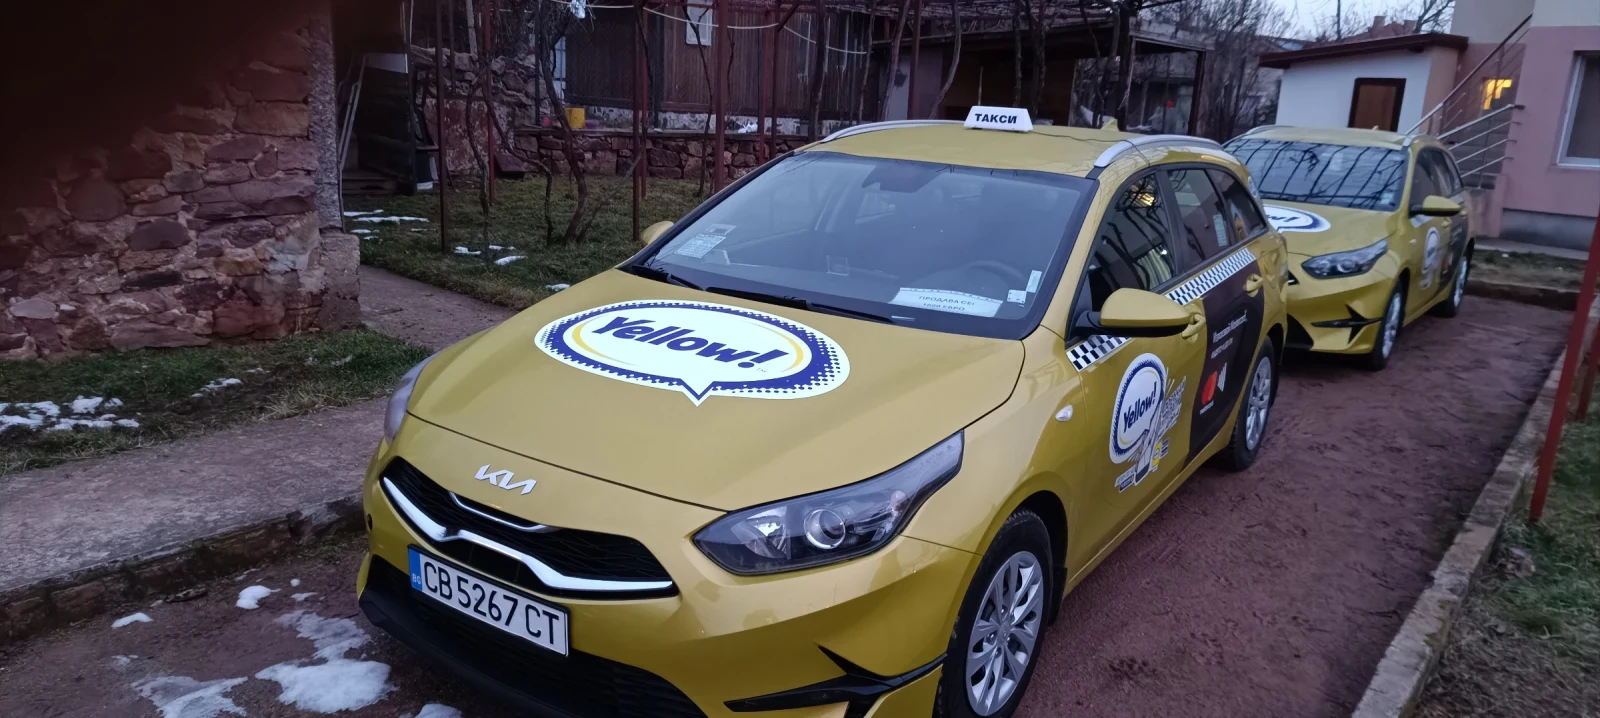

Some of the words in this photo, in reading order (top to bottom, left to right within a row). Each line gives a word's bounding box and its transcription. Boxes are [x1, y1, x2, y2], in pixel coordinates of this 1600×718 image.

[974, 113, 1018, 124] ТАКСИ
[918, 295, 959, 304] ПРОДАВА
[591, 316, 790, 369] Yellow!
[1123, 381, 1157, 432] Yellow!
[412, 573, 422, 585] BG
[456, 575, 518, 627] 5267
